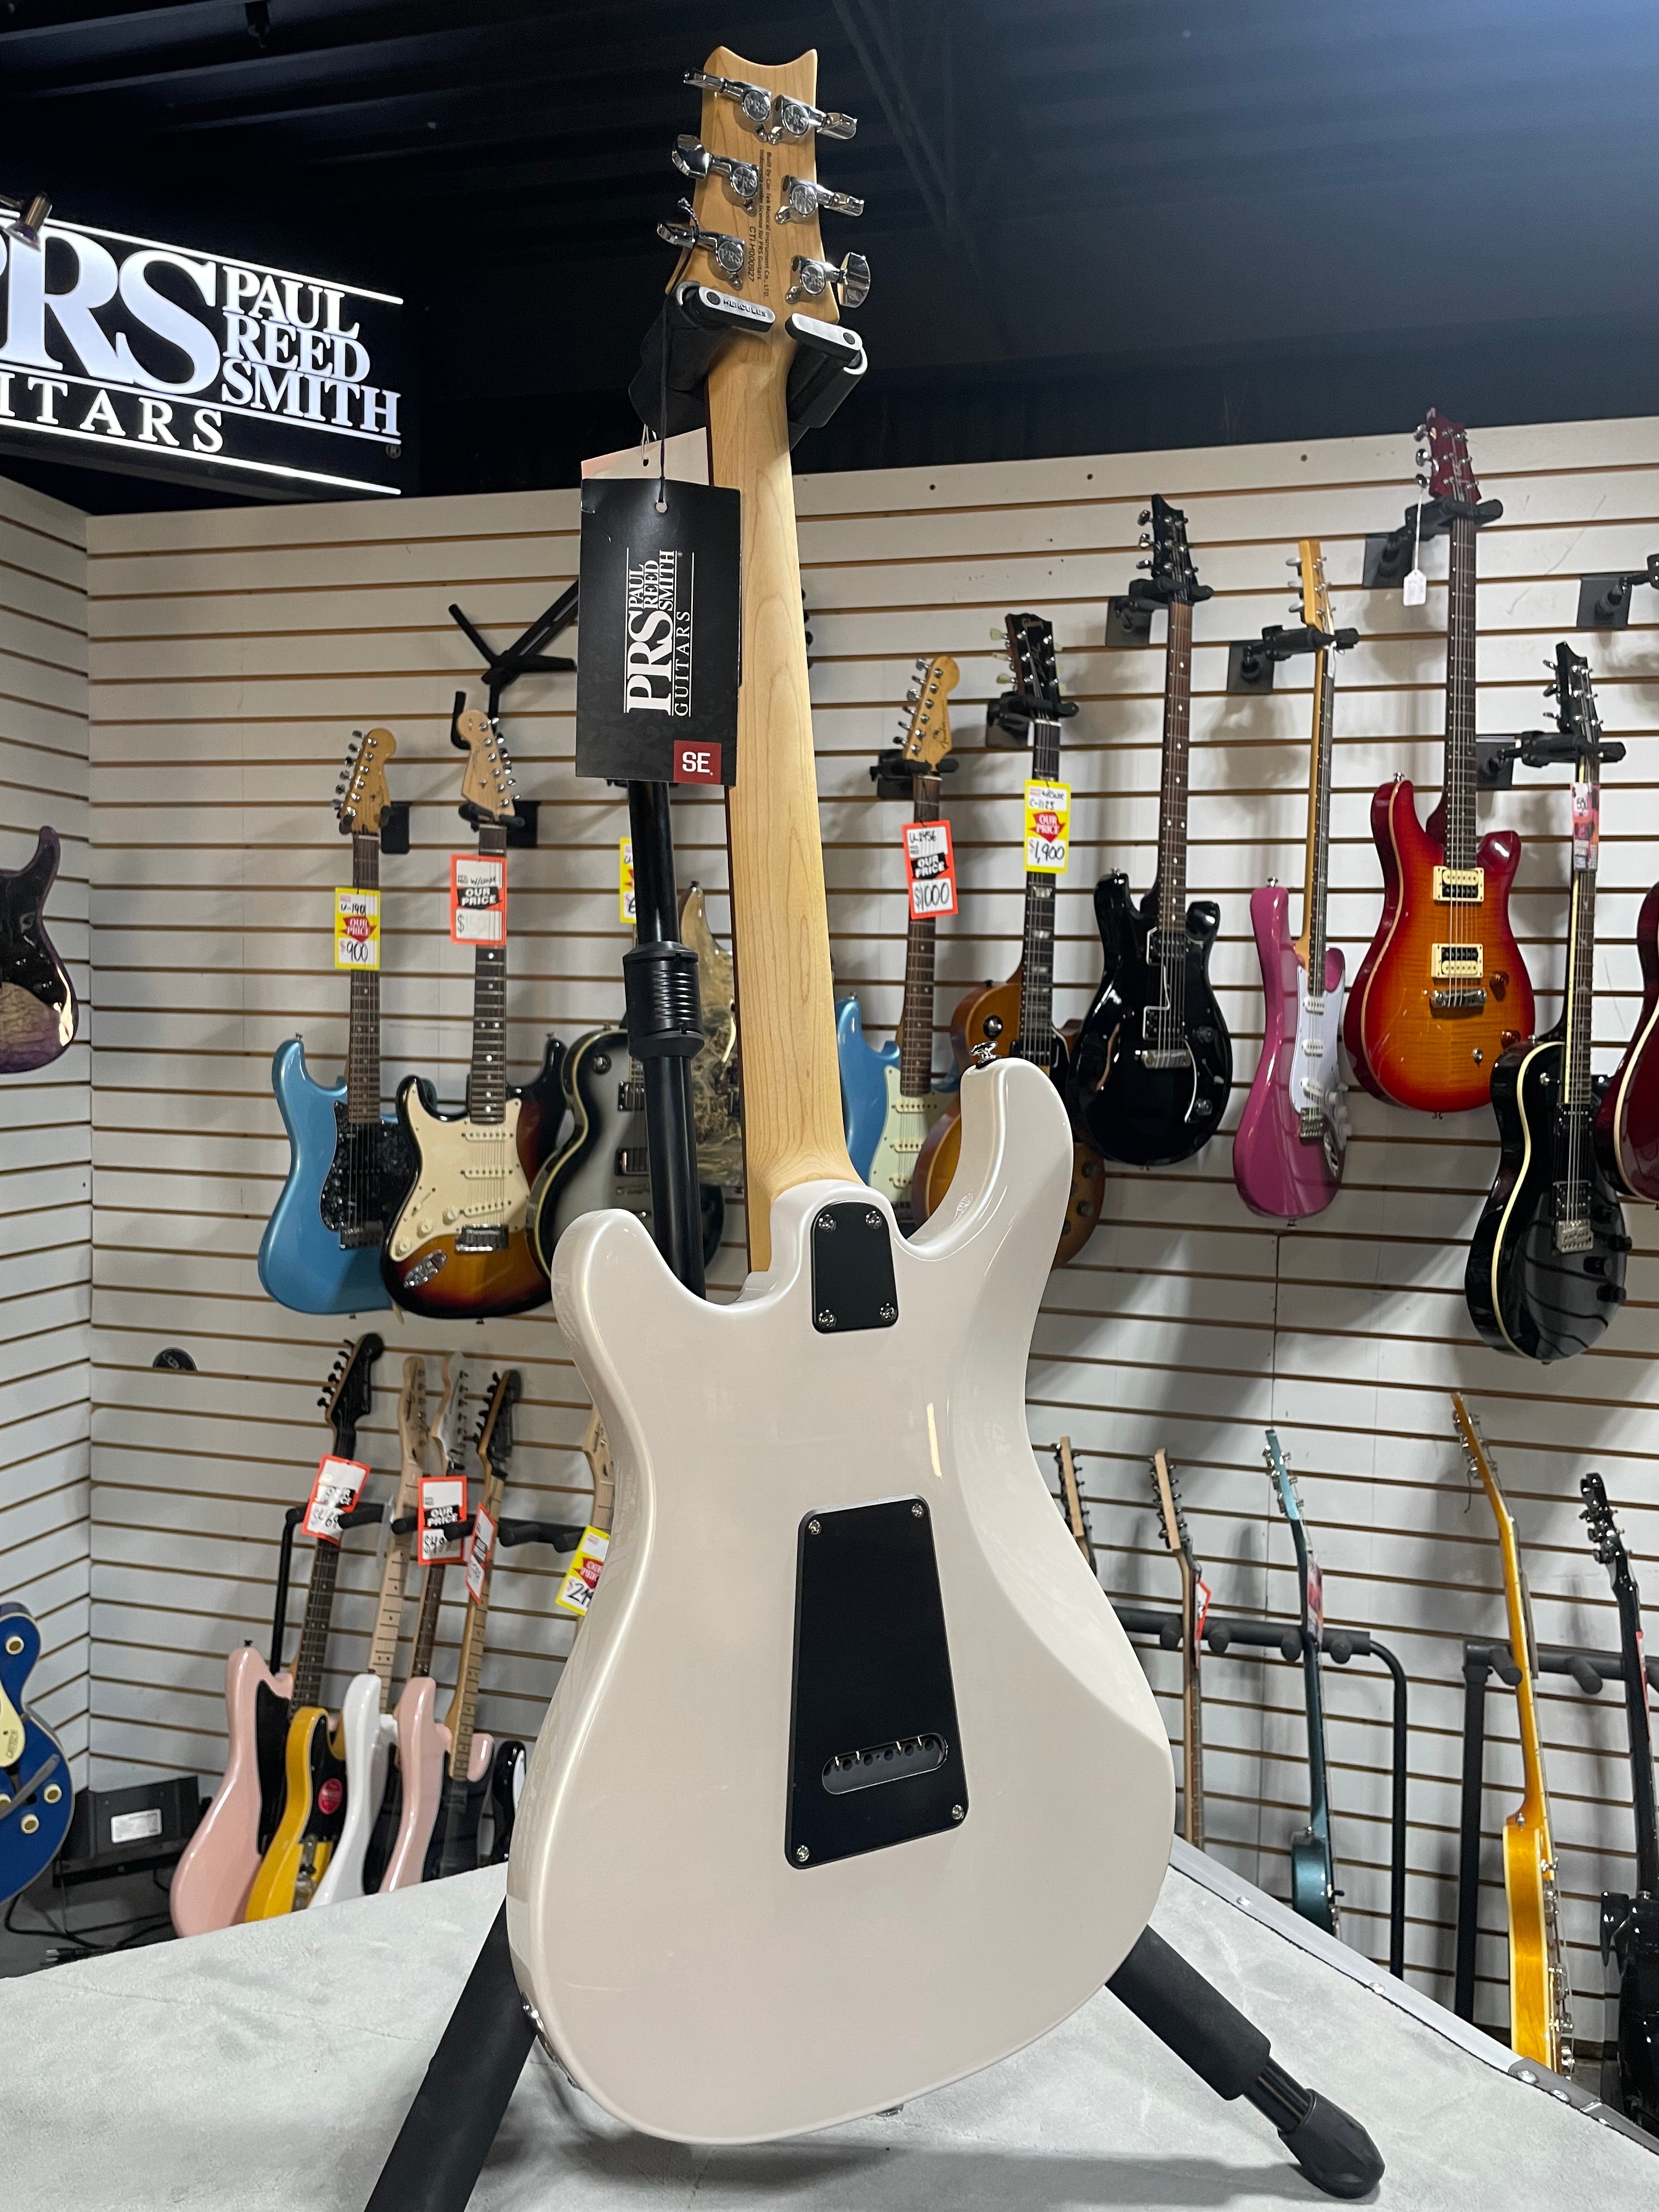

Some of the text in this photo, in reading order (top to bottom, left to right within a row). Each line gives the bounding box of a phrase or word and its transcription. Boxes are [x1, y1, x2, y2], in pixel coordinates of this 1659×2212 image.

[746, 98, 766, 114] PRS
[721, 249, 741, 264] PRS
[0, 229, 221, 394] RS
[222, 265, 360, 339] PAUL
[222, 311, 370, 383] REED
[221, 359, 402, 437] SMITH
[628, 564, 645, 608] PAUL
[643, 560, 659, 610] REED
[658, 550, 675, 611] SMITH
[626, 610, 674, 716] PRS
[674, 611, 690, 716] GUITARS
[1039, 814, 1058, 823] OUR
[1036, 823, 1060, 835] PRICE
[1029, 839, 1065, 864] $1,900
[915, 861, 945, 878] PRICE
[917, 855, 939, 868] OUR
[461, 894, 496, 907] PRICE
[465, 888, 490, 897] OUR
[914, 882, 950, 912] $1000
[347, 926, 371, 936] PRICE
[349, 918, 368, 927] OUR
[340, 941, 369, 963] $900
[427, 1513, 459, 1527] PRICE
[430, 1505, 454, 1518] OUR
